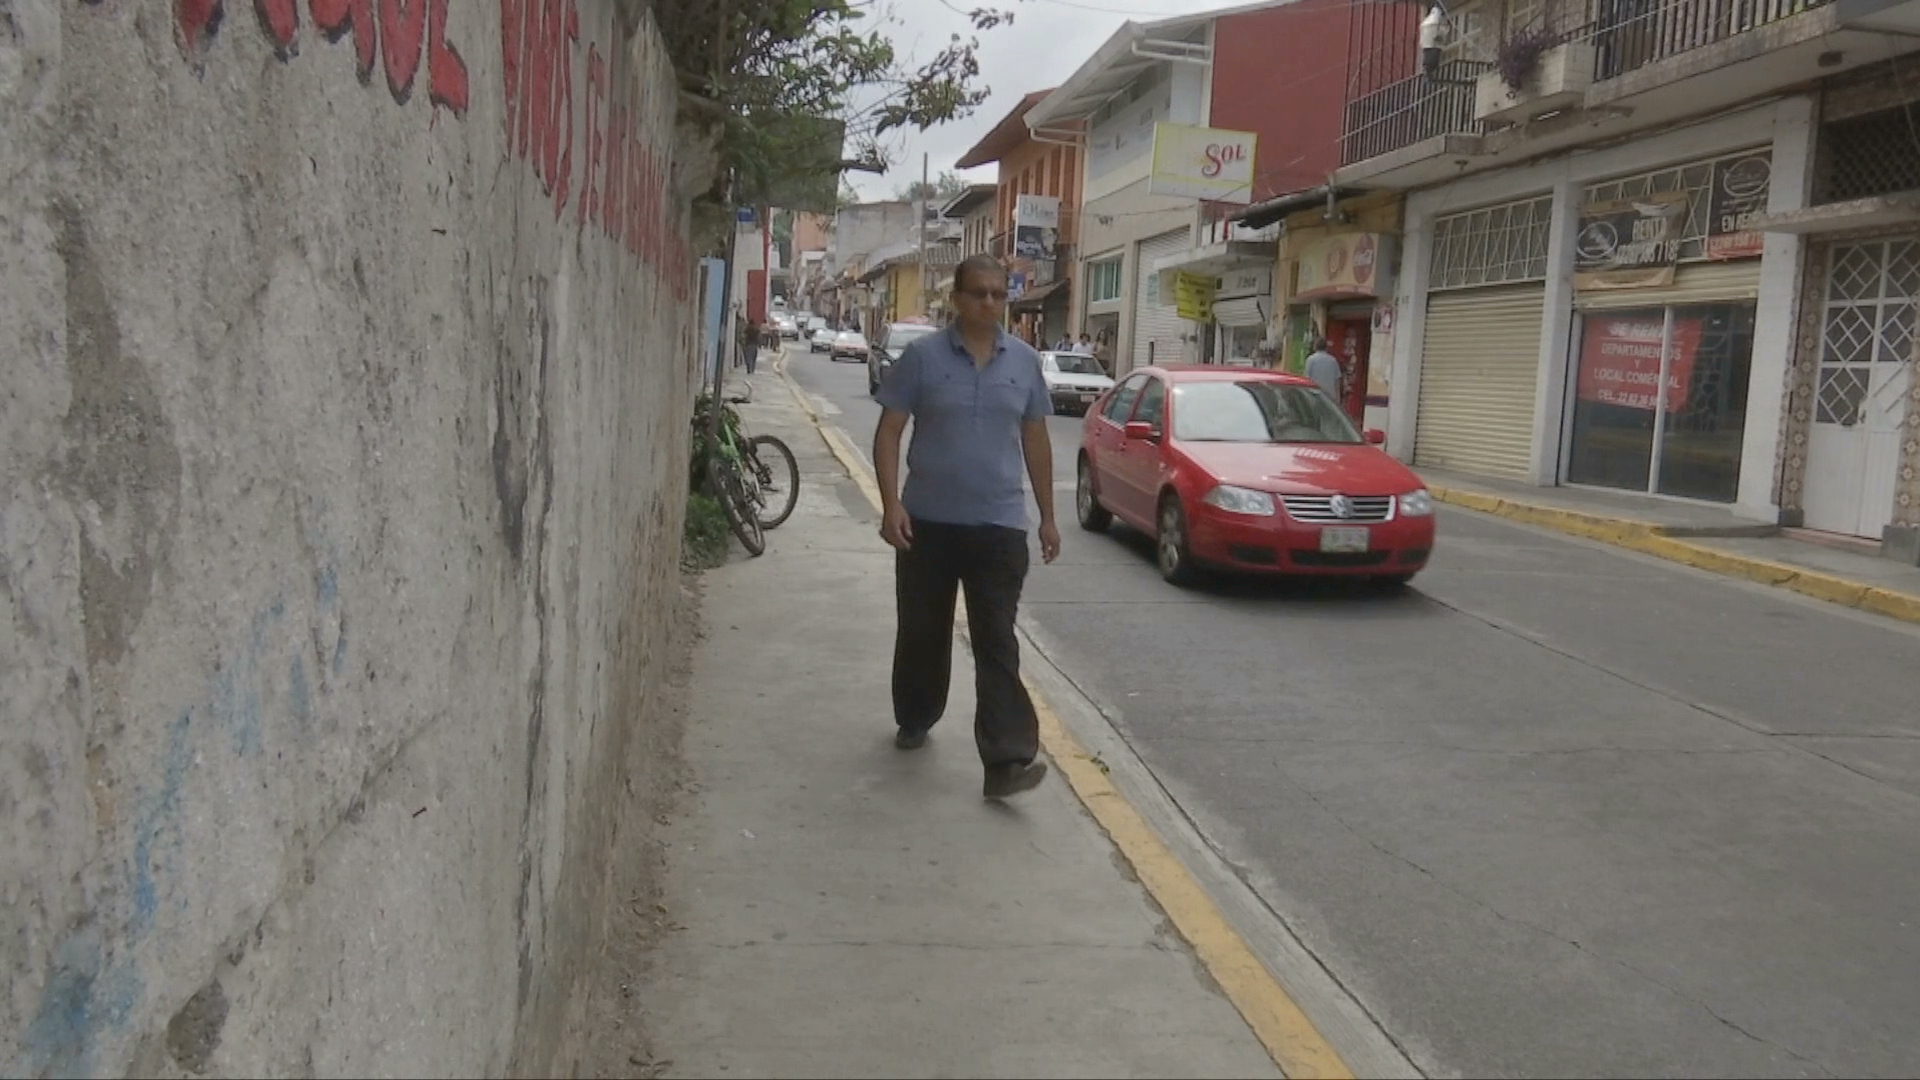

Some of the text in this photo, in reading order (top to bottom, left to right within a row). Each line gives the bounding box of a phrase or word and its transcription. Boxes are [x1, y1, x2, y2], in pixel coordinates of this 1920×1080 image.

[1602, 343, 1681, 360] DEPARTAMENOS
[1634, 359, 1640, 369] Y
[1594, 368, 1681, 389] LOCAL COMERAL
